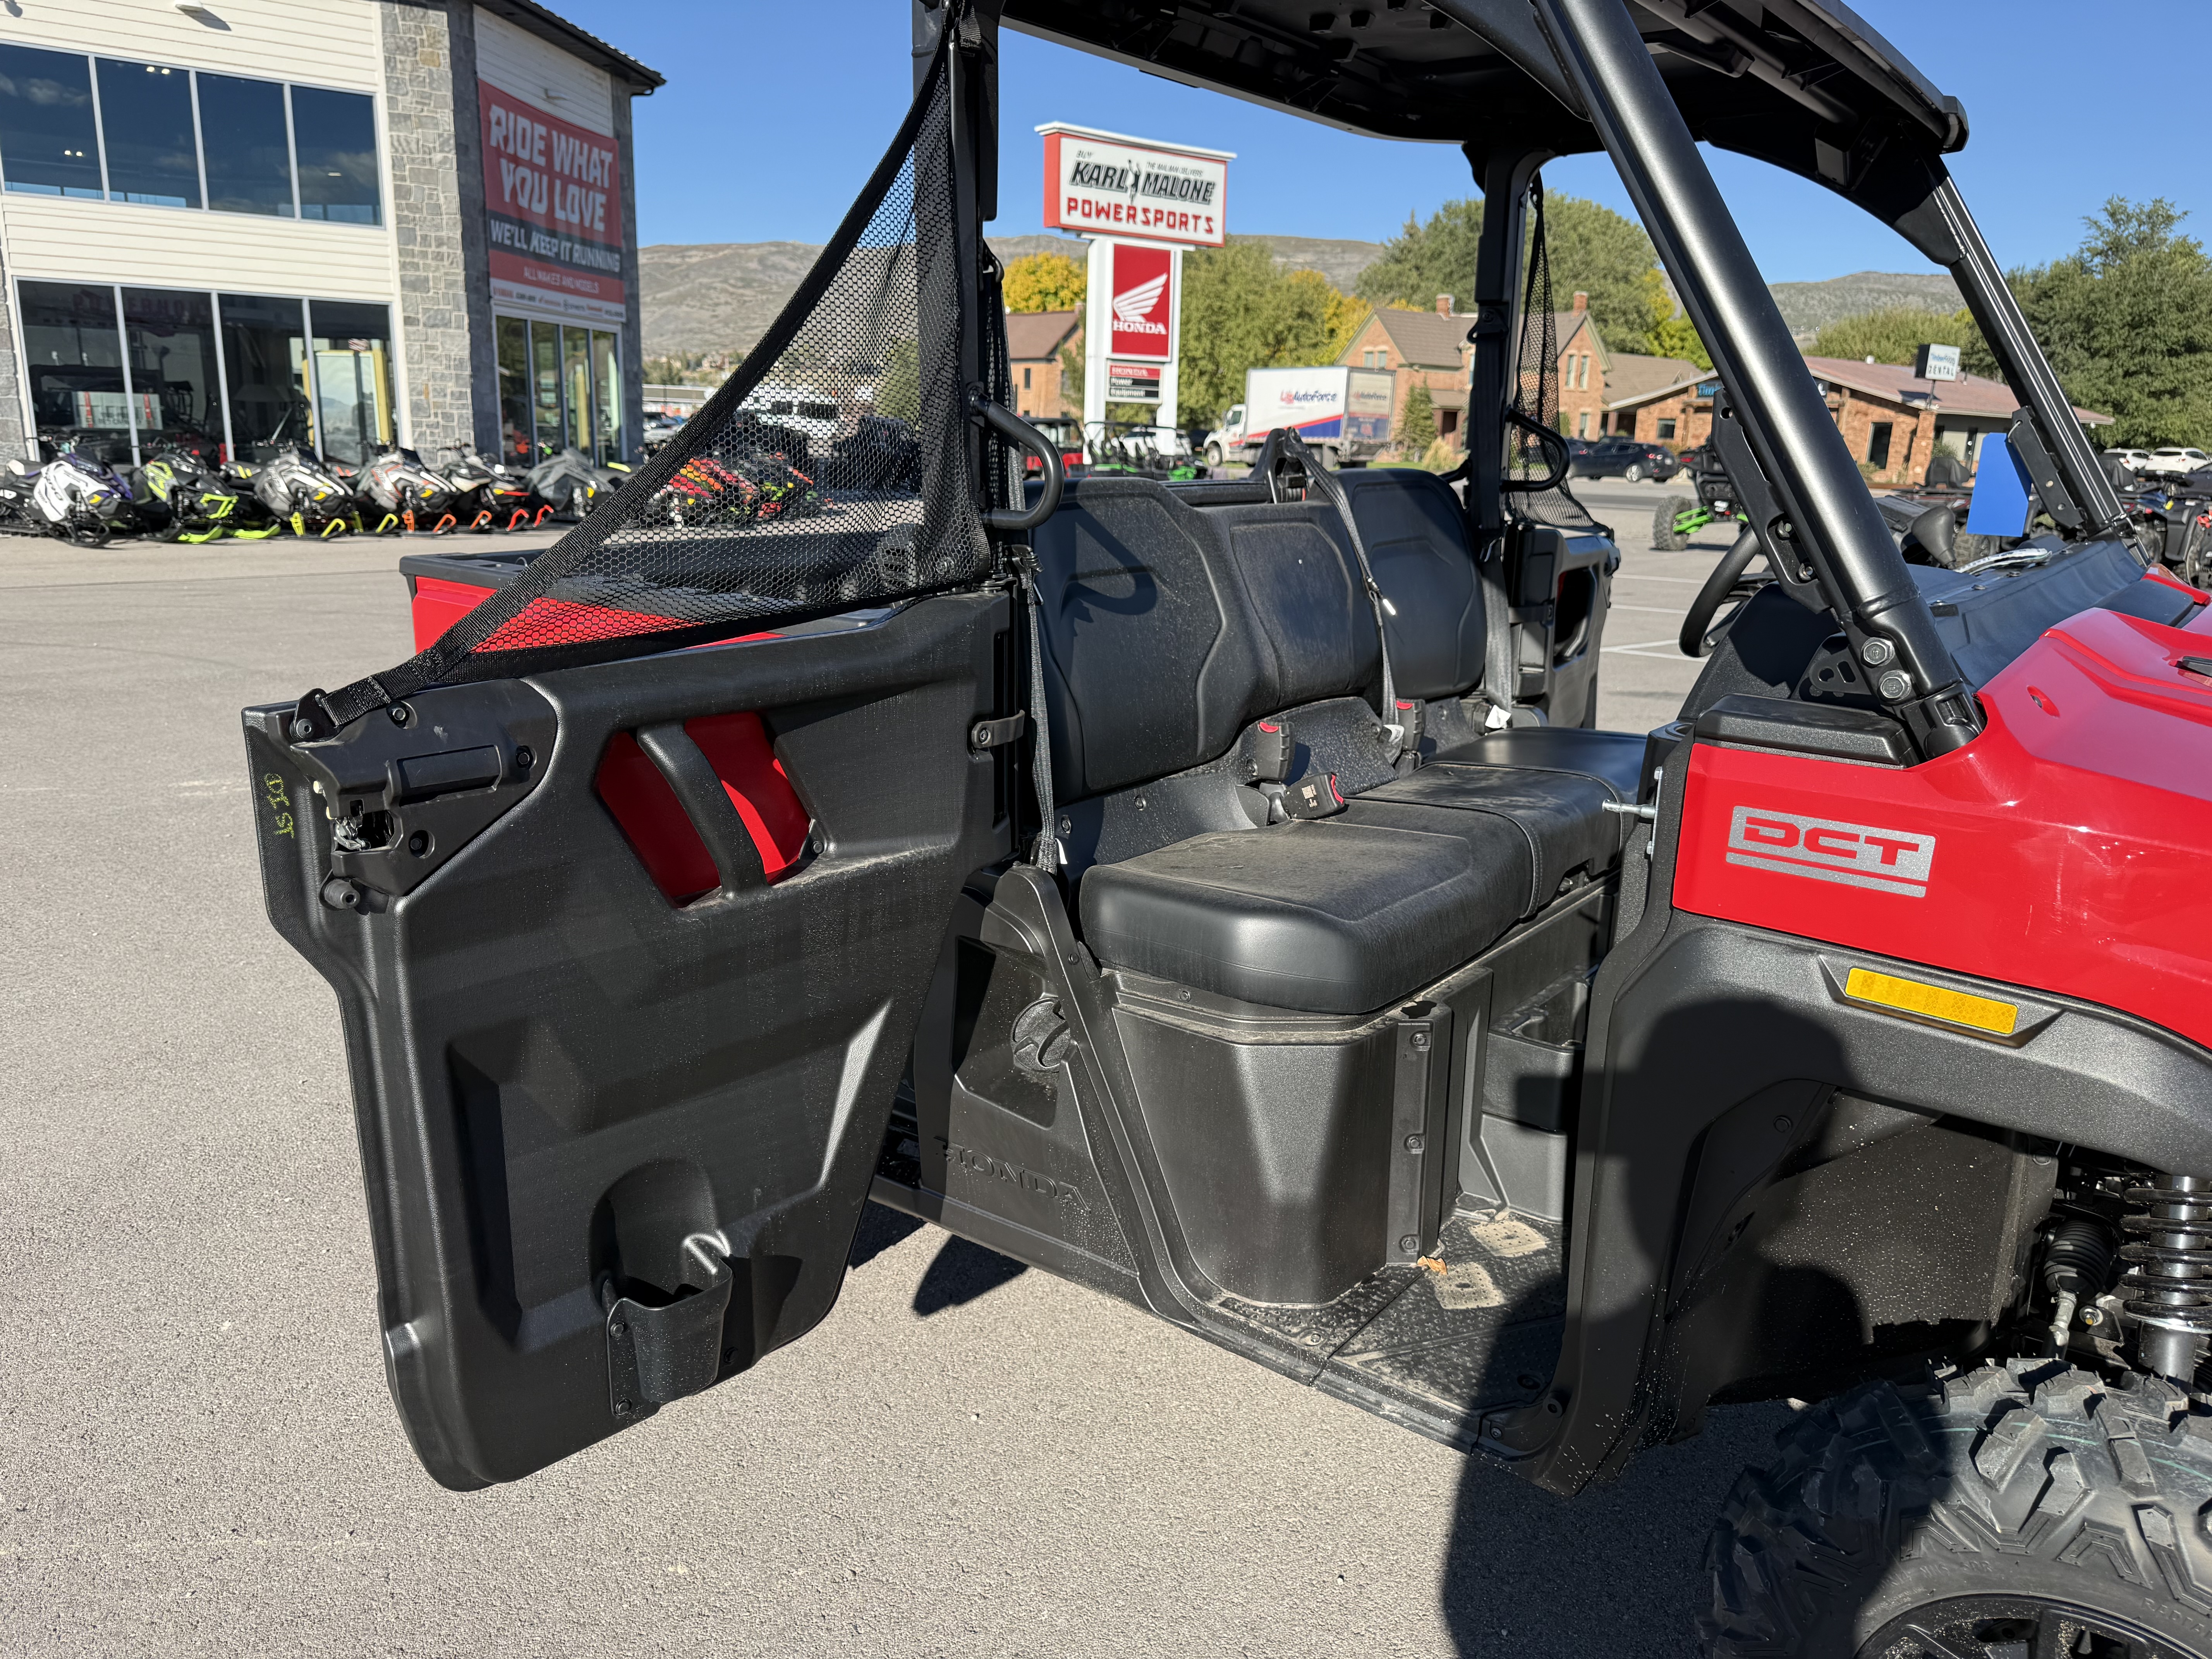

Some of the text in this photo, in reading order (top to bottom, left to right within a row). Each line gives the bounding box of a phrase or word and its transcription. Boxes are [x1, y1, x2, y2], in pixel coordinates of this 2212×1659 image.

[489, 104, 613, 189] RIDE WHAT
[500, 158, 607, 232] YOU LOVE
[1068, 159, 1217, 205] KARL MALONE
[1066, 197, 1214, 234] POWERSPORTS
[490, 219, 620, 273] WE'LL KEEP IT RUNNING
[524, 266, 600, 294] ALL MAKES AND MODELS
[1112, 319, 1167, 334] HONDA
[1111, 366, 1148, 377] HONDA
[1111, 377, 1133, 386] Power
[1928, 365, 1953, 376] DENTAL
[1743, 816, 1919, 866] DCT
[934, 1135, 1092, 1214] HONDA
